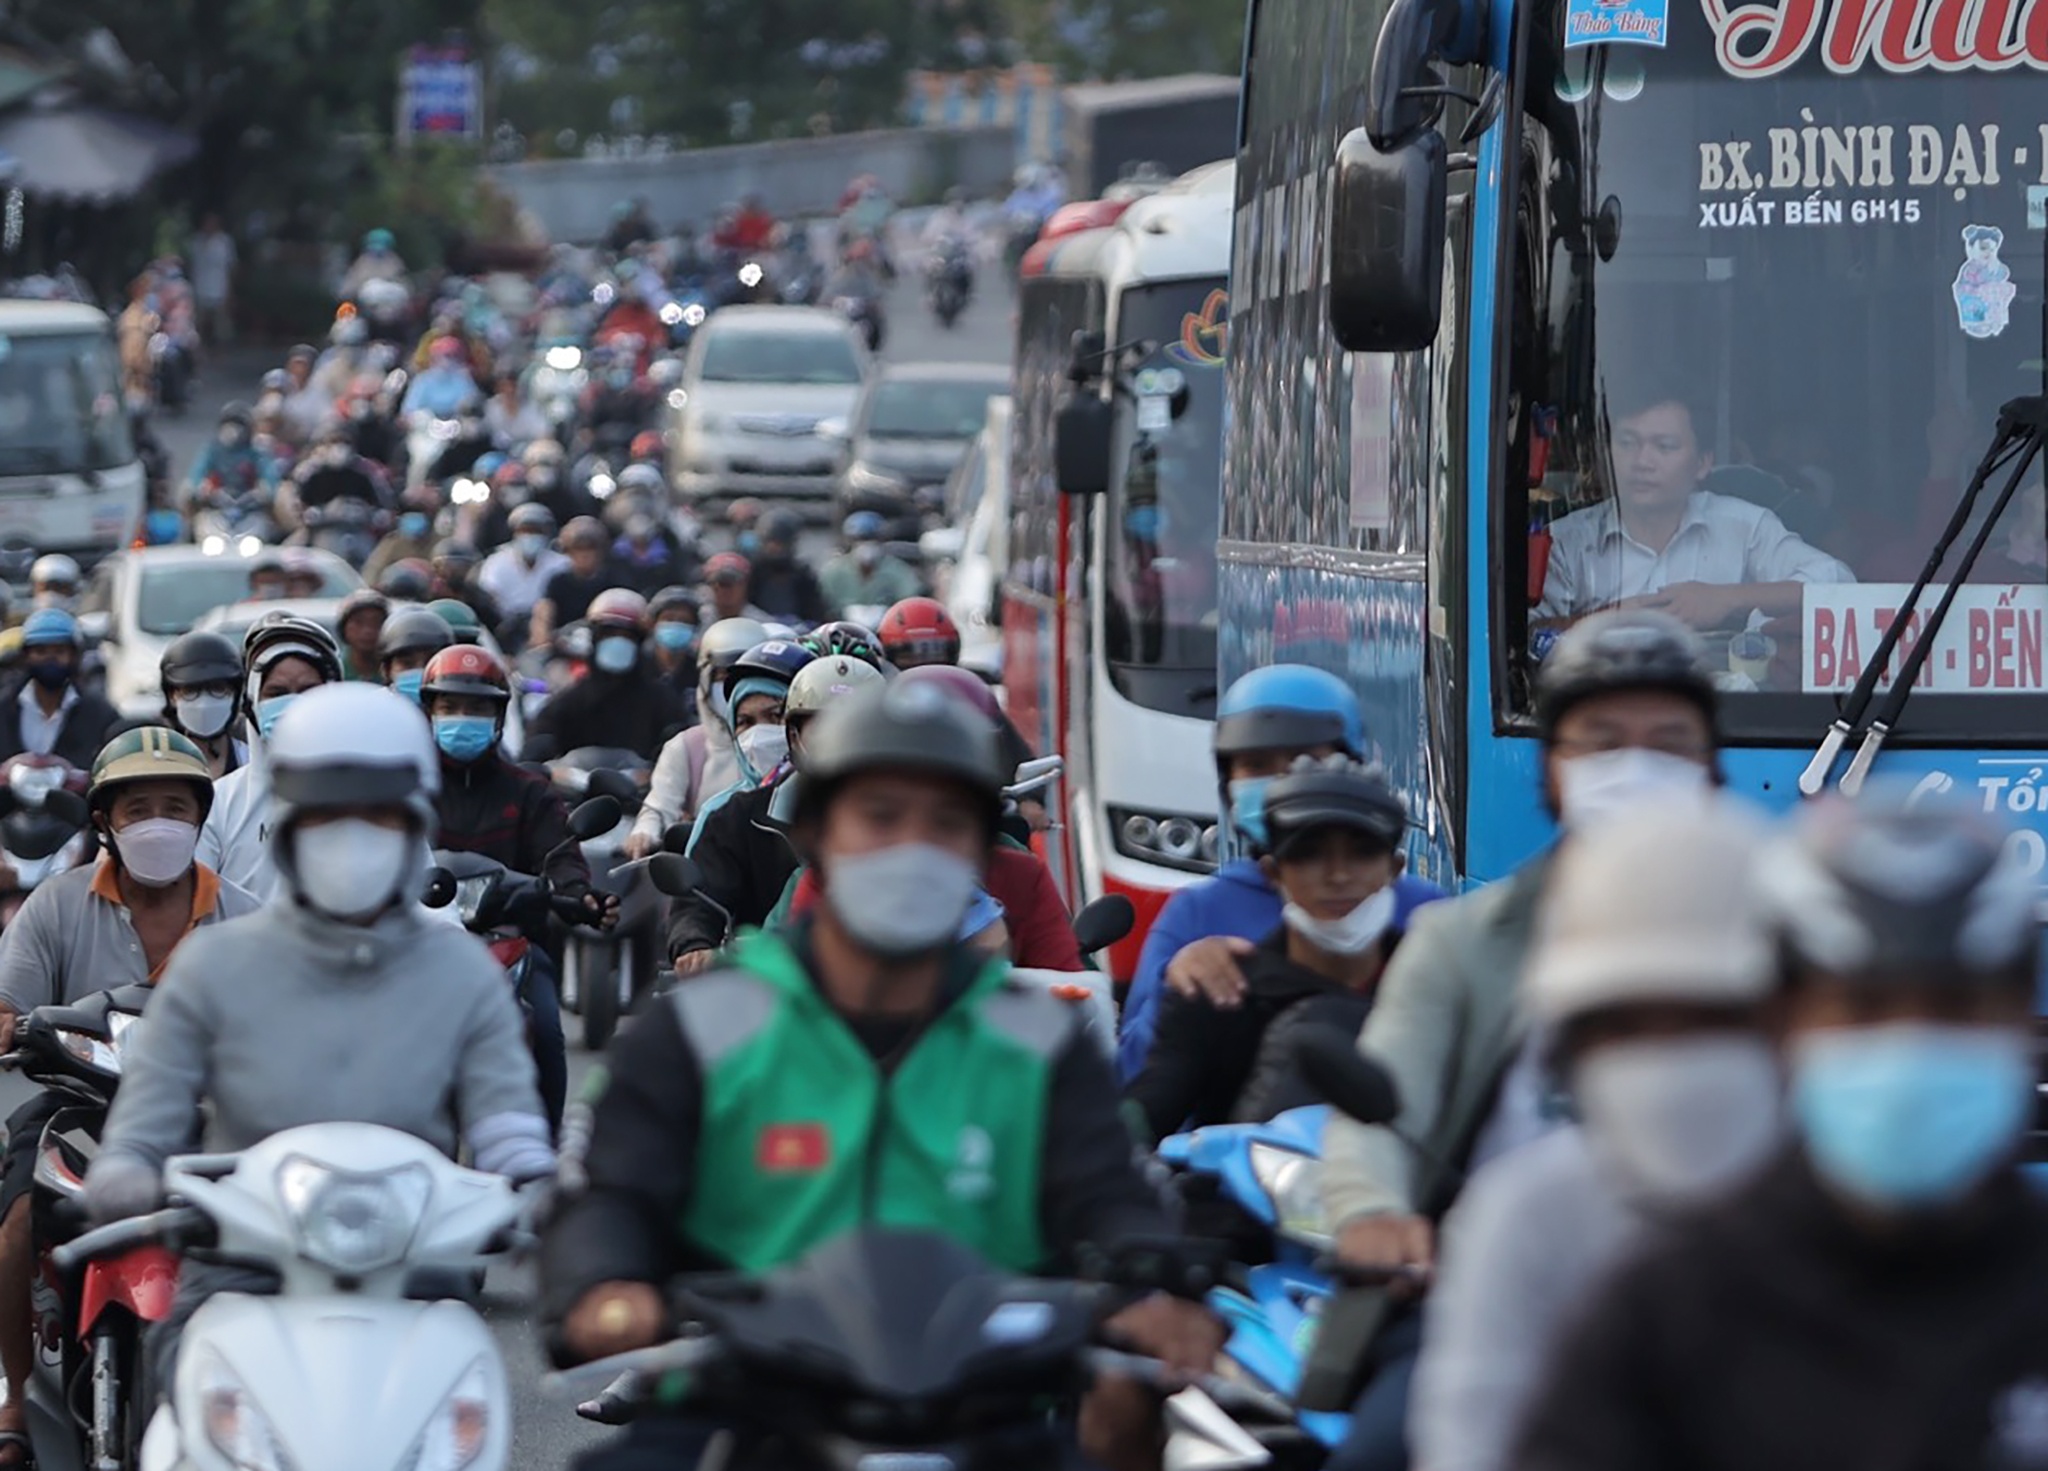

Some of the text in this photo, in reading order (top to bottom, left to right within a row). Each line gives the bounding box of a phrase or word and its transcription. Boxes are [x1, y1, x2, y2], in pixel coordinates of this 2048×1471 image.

[1908, 123, 2000, 201] ĐẠI
[1699, 190, 1920, 227] XUẤT BẾN 6H15
[1814, 607, 1861, 687] BA
[1969, 586, 2042, 688] BẾN
